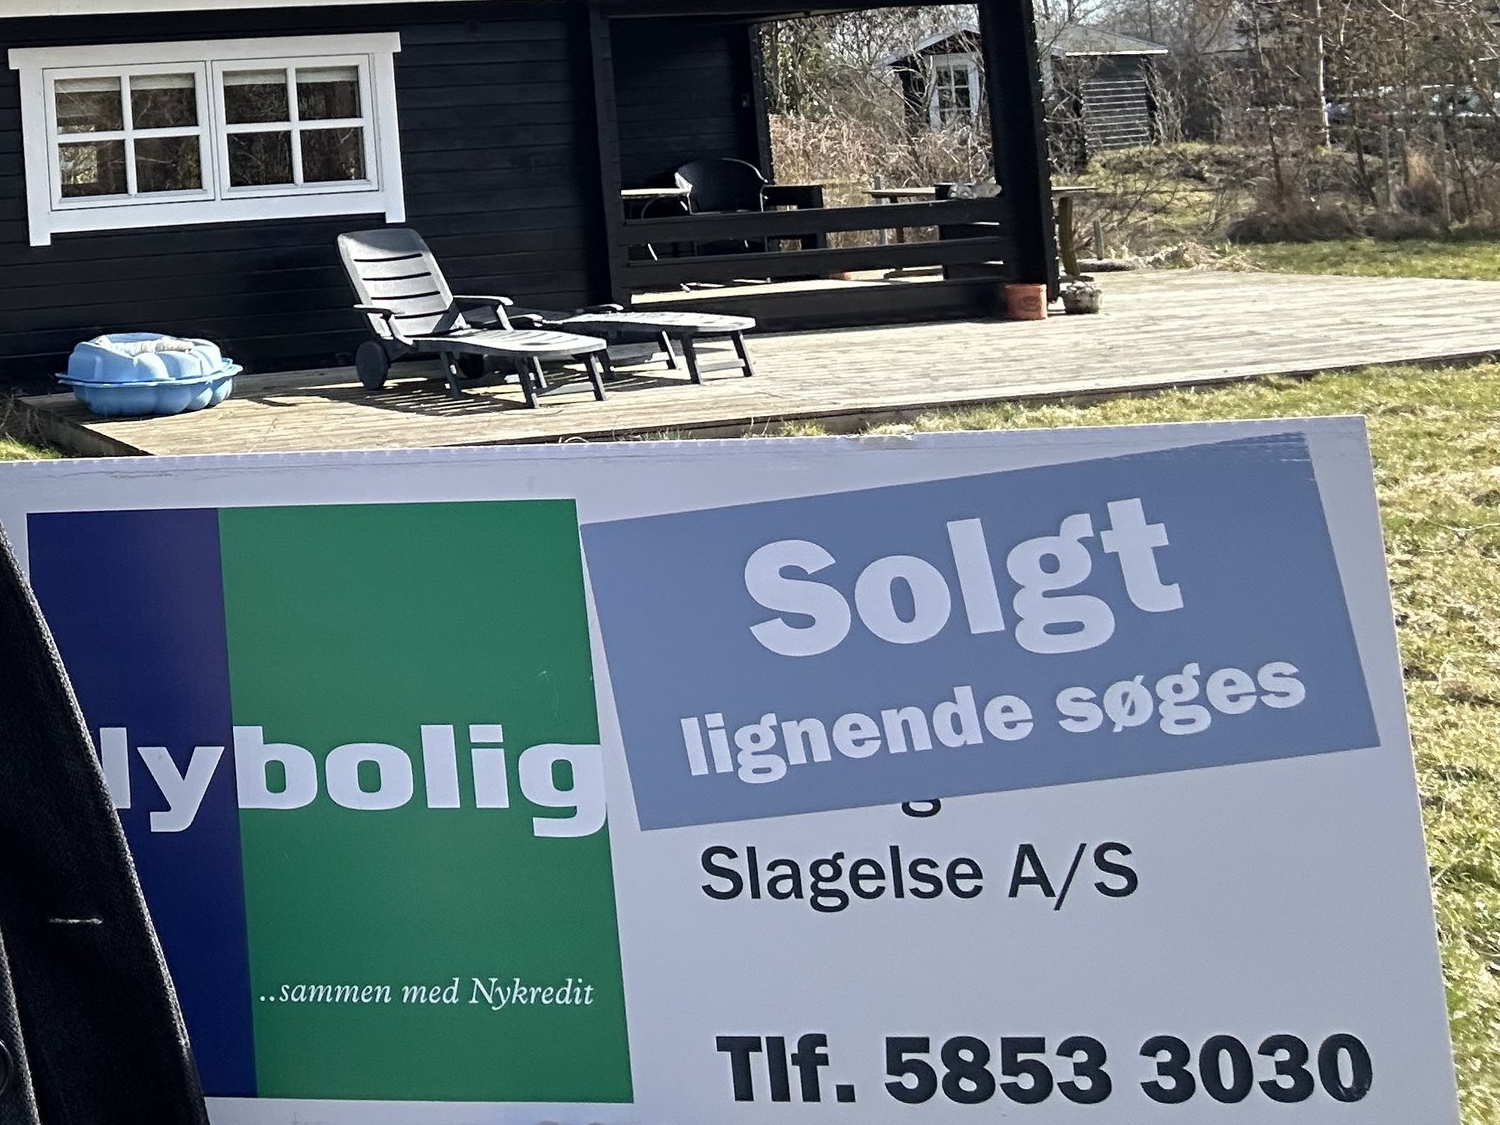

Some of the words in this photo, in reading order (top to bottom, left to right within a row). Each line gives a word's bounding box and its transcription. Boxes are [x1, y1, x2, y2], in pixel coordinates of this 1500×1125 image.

[744, 497, 1184, 657] Solgt
[680, 685, 1034, 784] lignende
[1055, 661, 1306, 736] søges
[701, 845, 984, 913] Slagelse
[1008, 841, 1139, 911] A/S
[401, 977, 460, 1005] med
[468, 976, 594, 1011] Nykredit
[715, 1033, 856, 1103] Tlf.
[884, 1035, 1113, 1105] 5853
[1139, 1033, 1373, 1104] 3030
